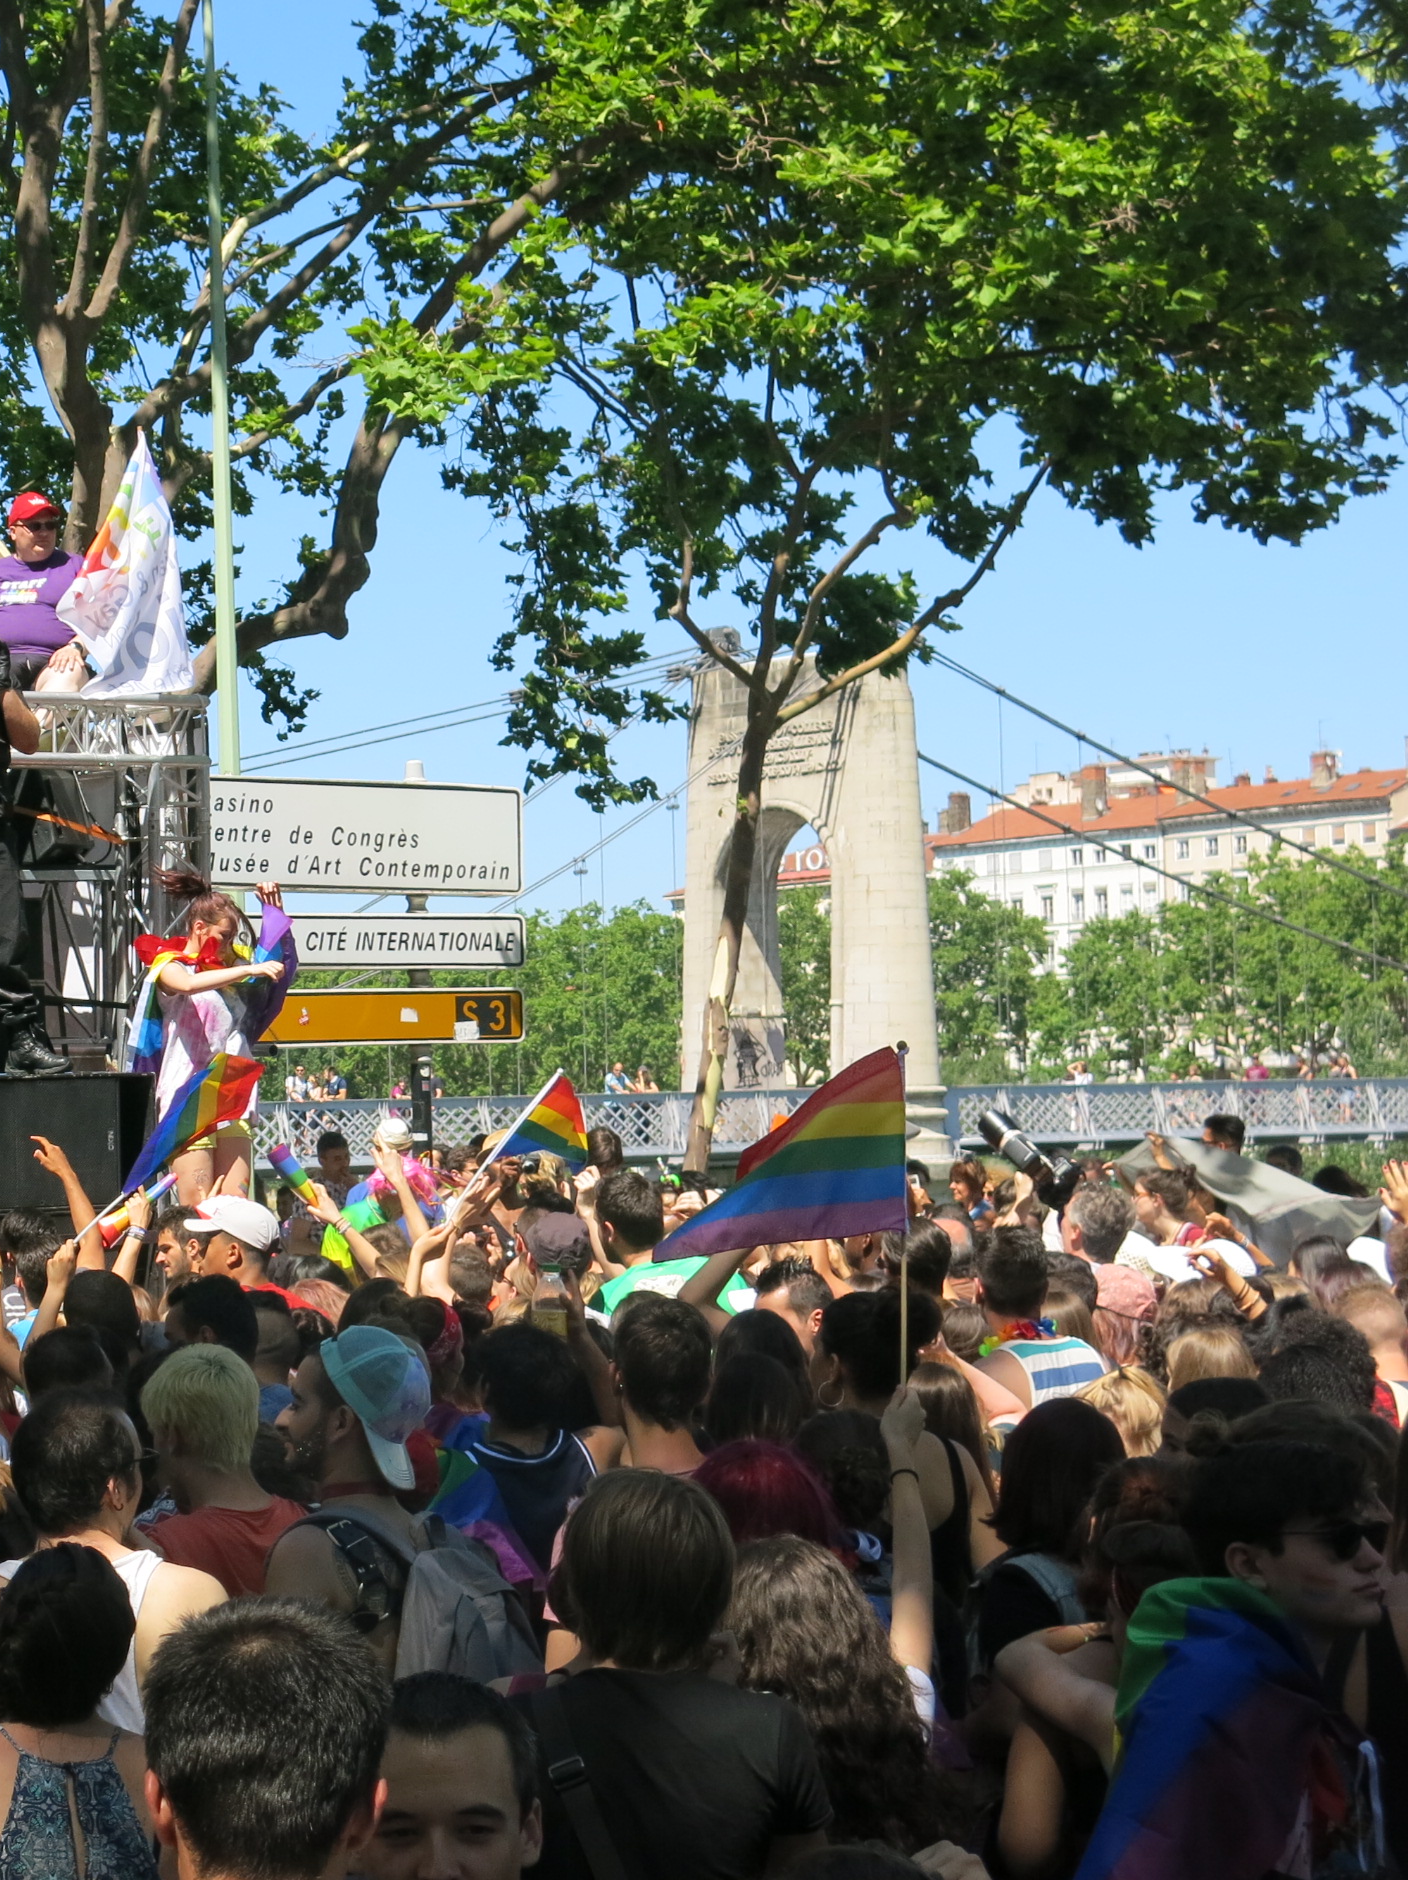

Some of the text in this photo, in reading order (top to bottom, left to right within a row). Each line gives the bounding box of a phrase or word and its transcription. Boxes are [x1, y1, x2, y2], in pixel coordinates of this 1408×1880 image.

[209, 792, 275, 816] asino
[209, 824, 420, 853] entre de Congrès
[359, 856, 511, 884] Contemporain
[305, 926, 516, 953] CITÉ INTERNATIONALE
